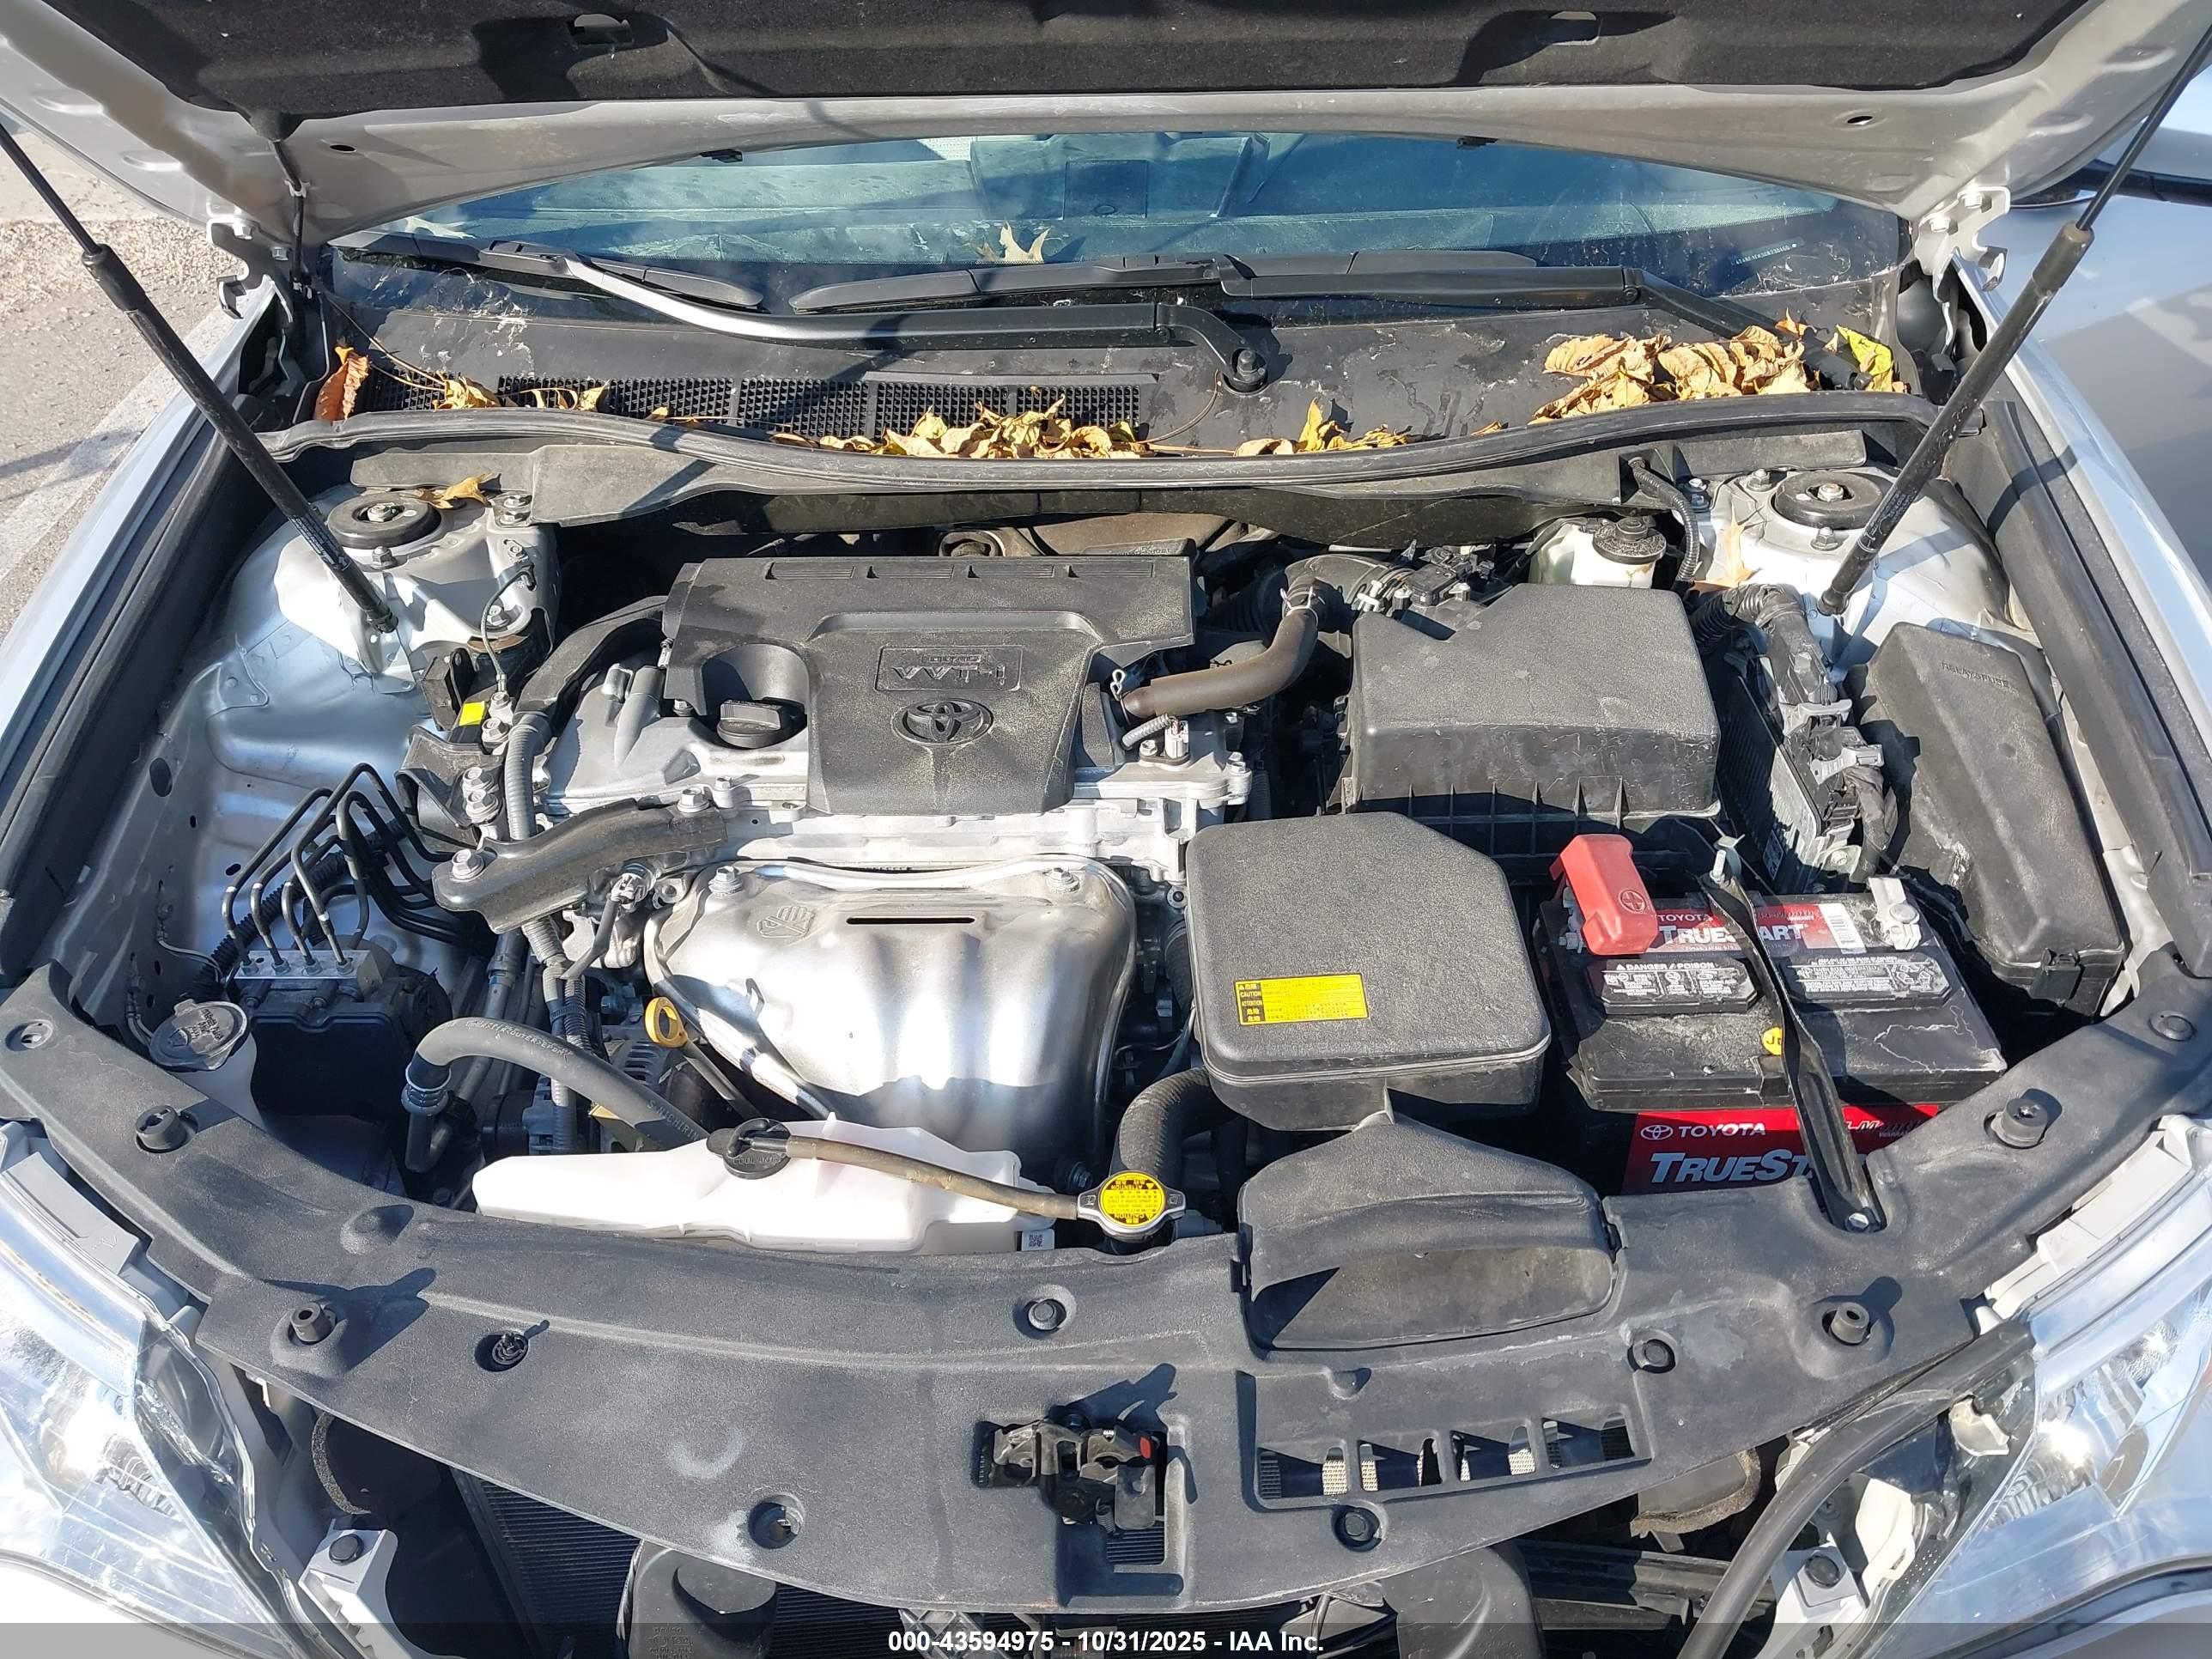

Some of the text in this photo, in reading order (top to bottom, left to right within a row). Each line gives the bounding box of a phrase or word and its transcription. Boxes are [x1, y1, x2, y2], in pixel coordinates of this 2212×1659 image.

[1659, 914, 1713, 922] TOYOTA
[1626, 963, 1668, 971] DANGER
[1677, 962, 1716, 970] POISON
[1678, 1122, 1766, 1138] TOYOTA
